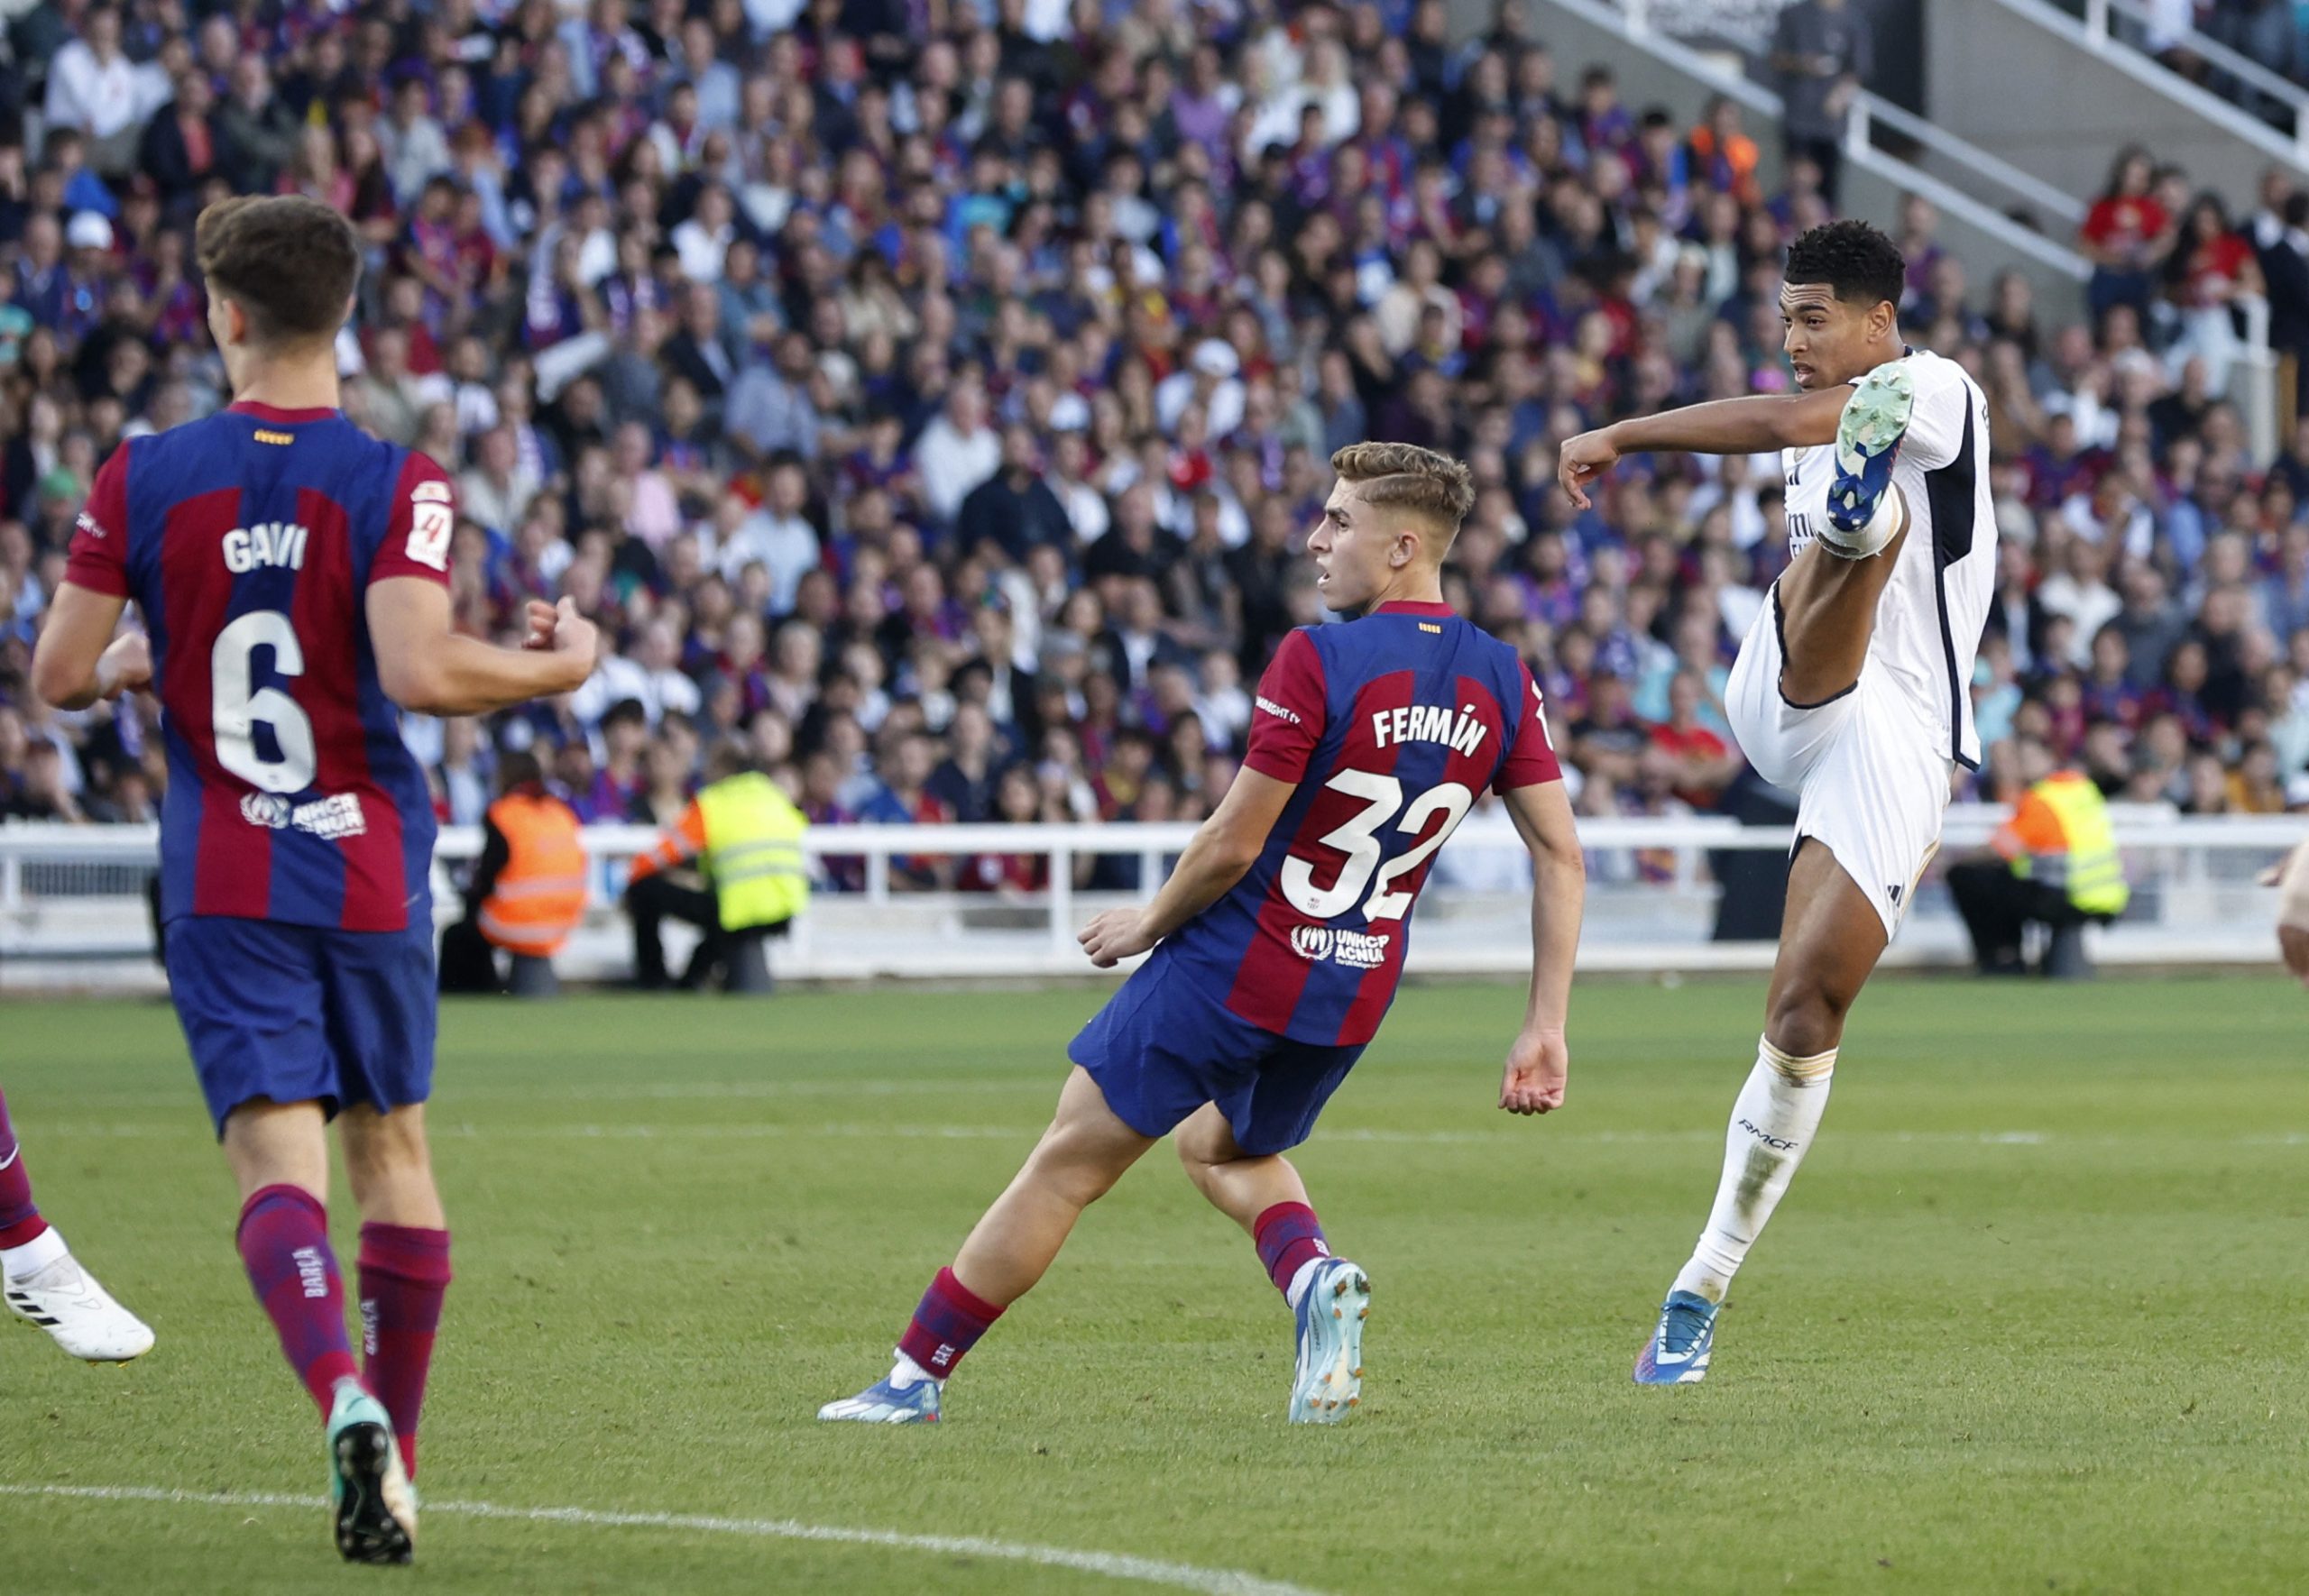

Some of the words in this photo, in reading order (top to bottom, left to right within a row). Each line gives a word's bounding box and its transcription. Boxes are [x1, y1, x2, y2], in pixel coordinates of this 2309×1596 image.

[222, 520, 308, 573] GAVI
[211, 610, 317, 793] 6
[1372, 703, 1487, 757] FERMÍN
[1281, 767, 1473, 923] 32
[1738, 1119, 1798, 1151] RMCF
[291, 1247, 327, 1298] BARÇA
[931, 1343, 956, 1367] BAR
